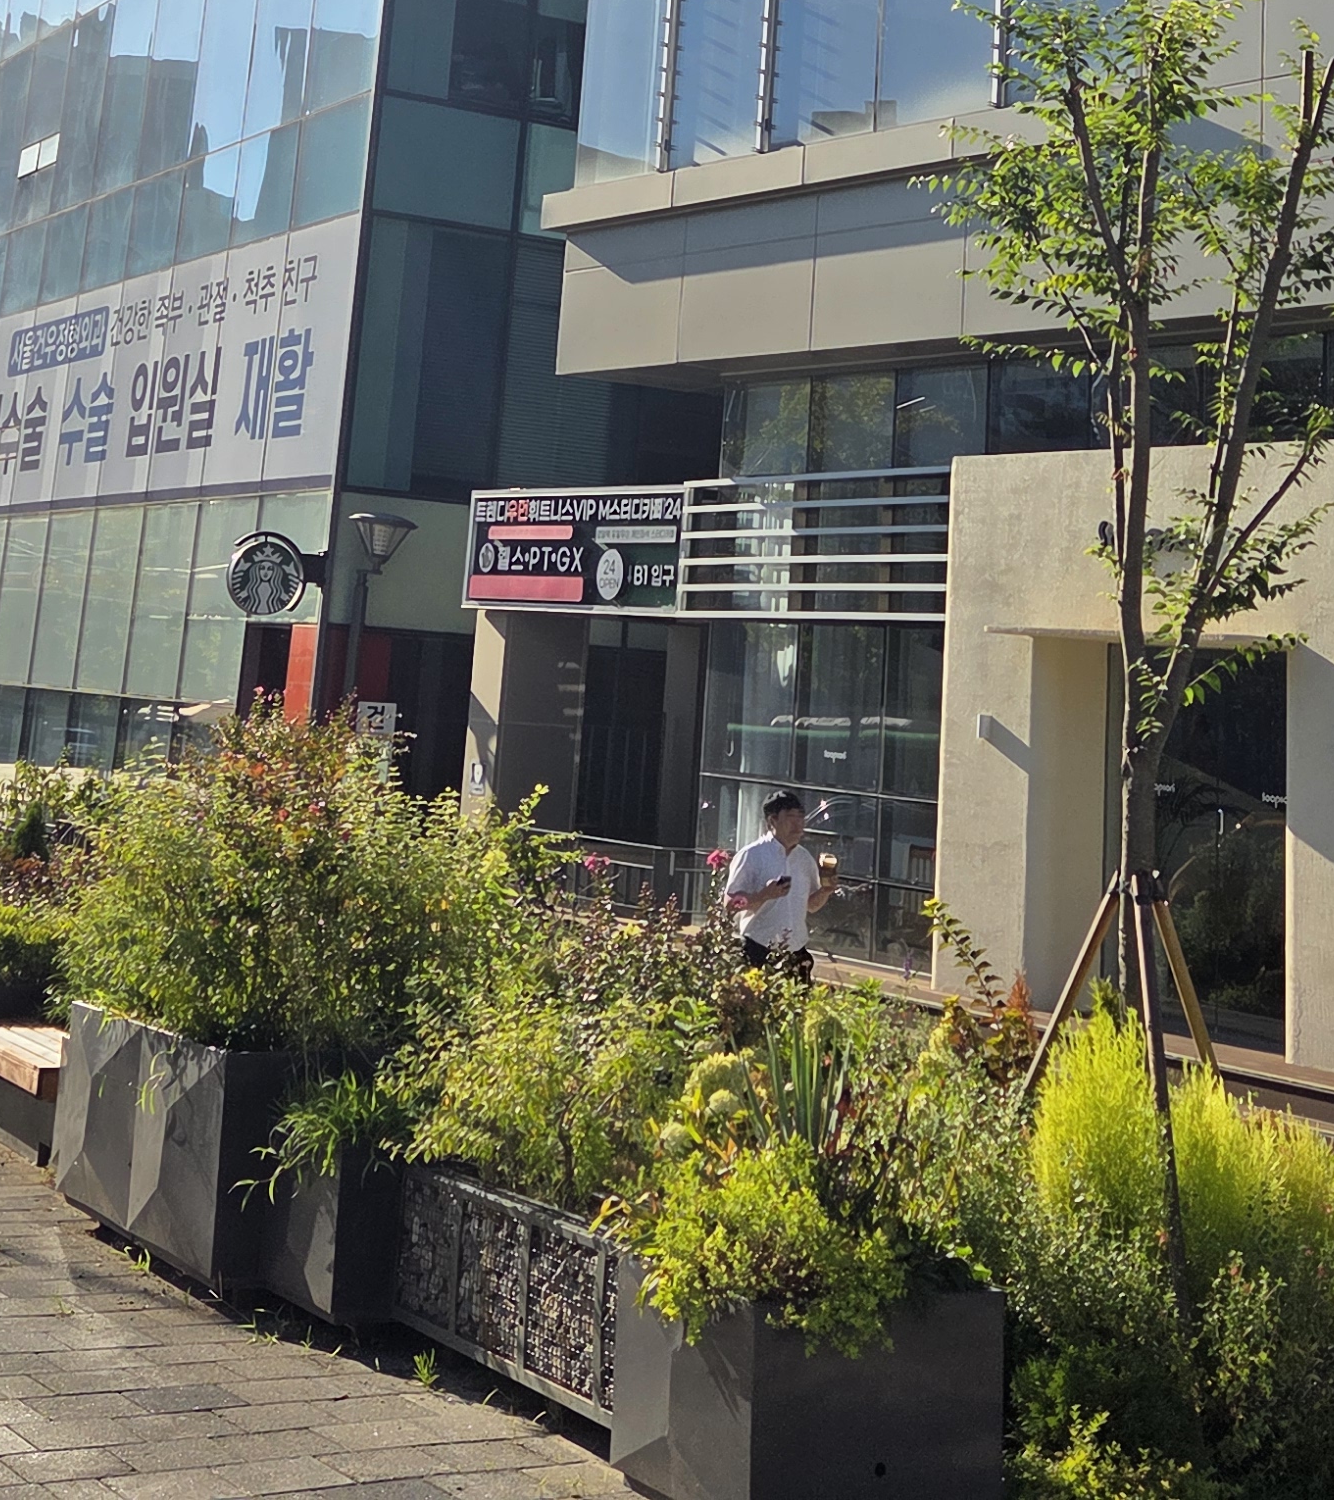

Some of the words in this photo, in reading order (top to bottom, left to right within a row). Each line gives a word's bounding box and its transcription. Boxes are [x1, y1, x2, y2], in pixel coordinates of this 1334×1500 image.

[10, 311, 106, 372] 서울건우정형외과
[110, 299, 152, 347] 건강한
[154, 289, 185, 334] 족부
[197, 277, 230, 326] 관절
[243, 265, 277, 315] 척추
[283, 255, 319, 307] 친구
[59, 371, 115, 466] 수술
[125, 346, 223, 458] 입원실
[234, 328, 315, 440] 재활
[603, 559, 616, 576] 24
[633, 564, 648, 586] B1
[651, 565, 675, 587] 입구
[599, 578, 619, 589] OPEN
